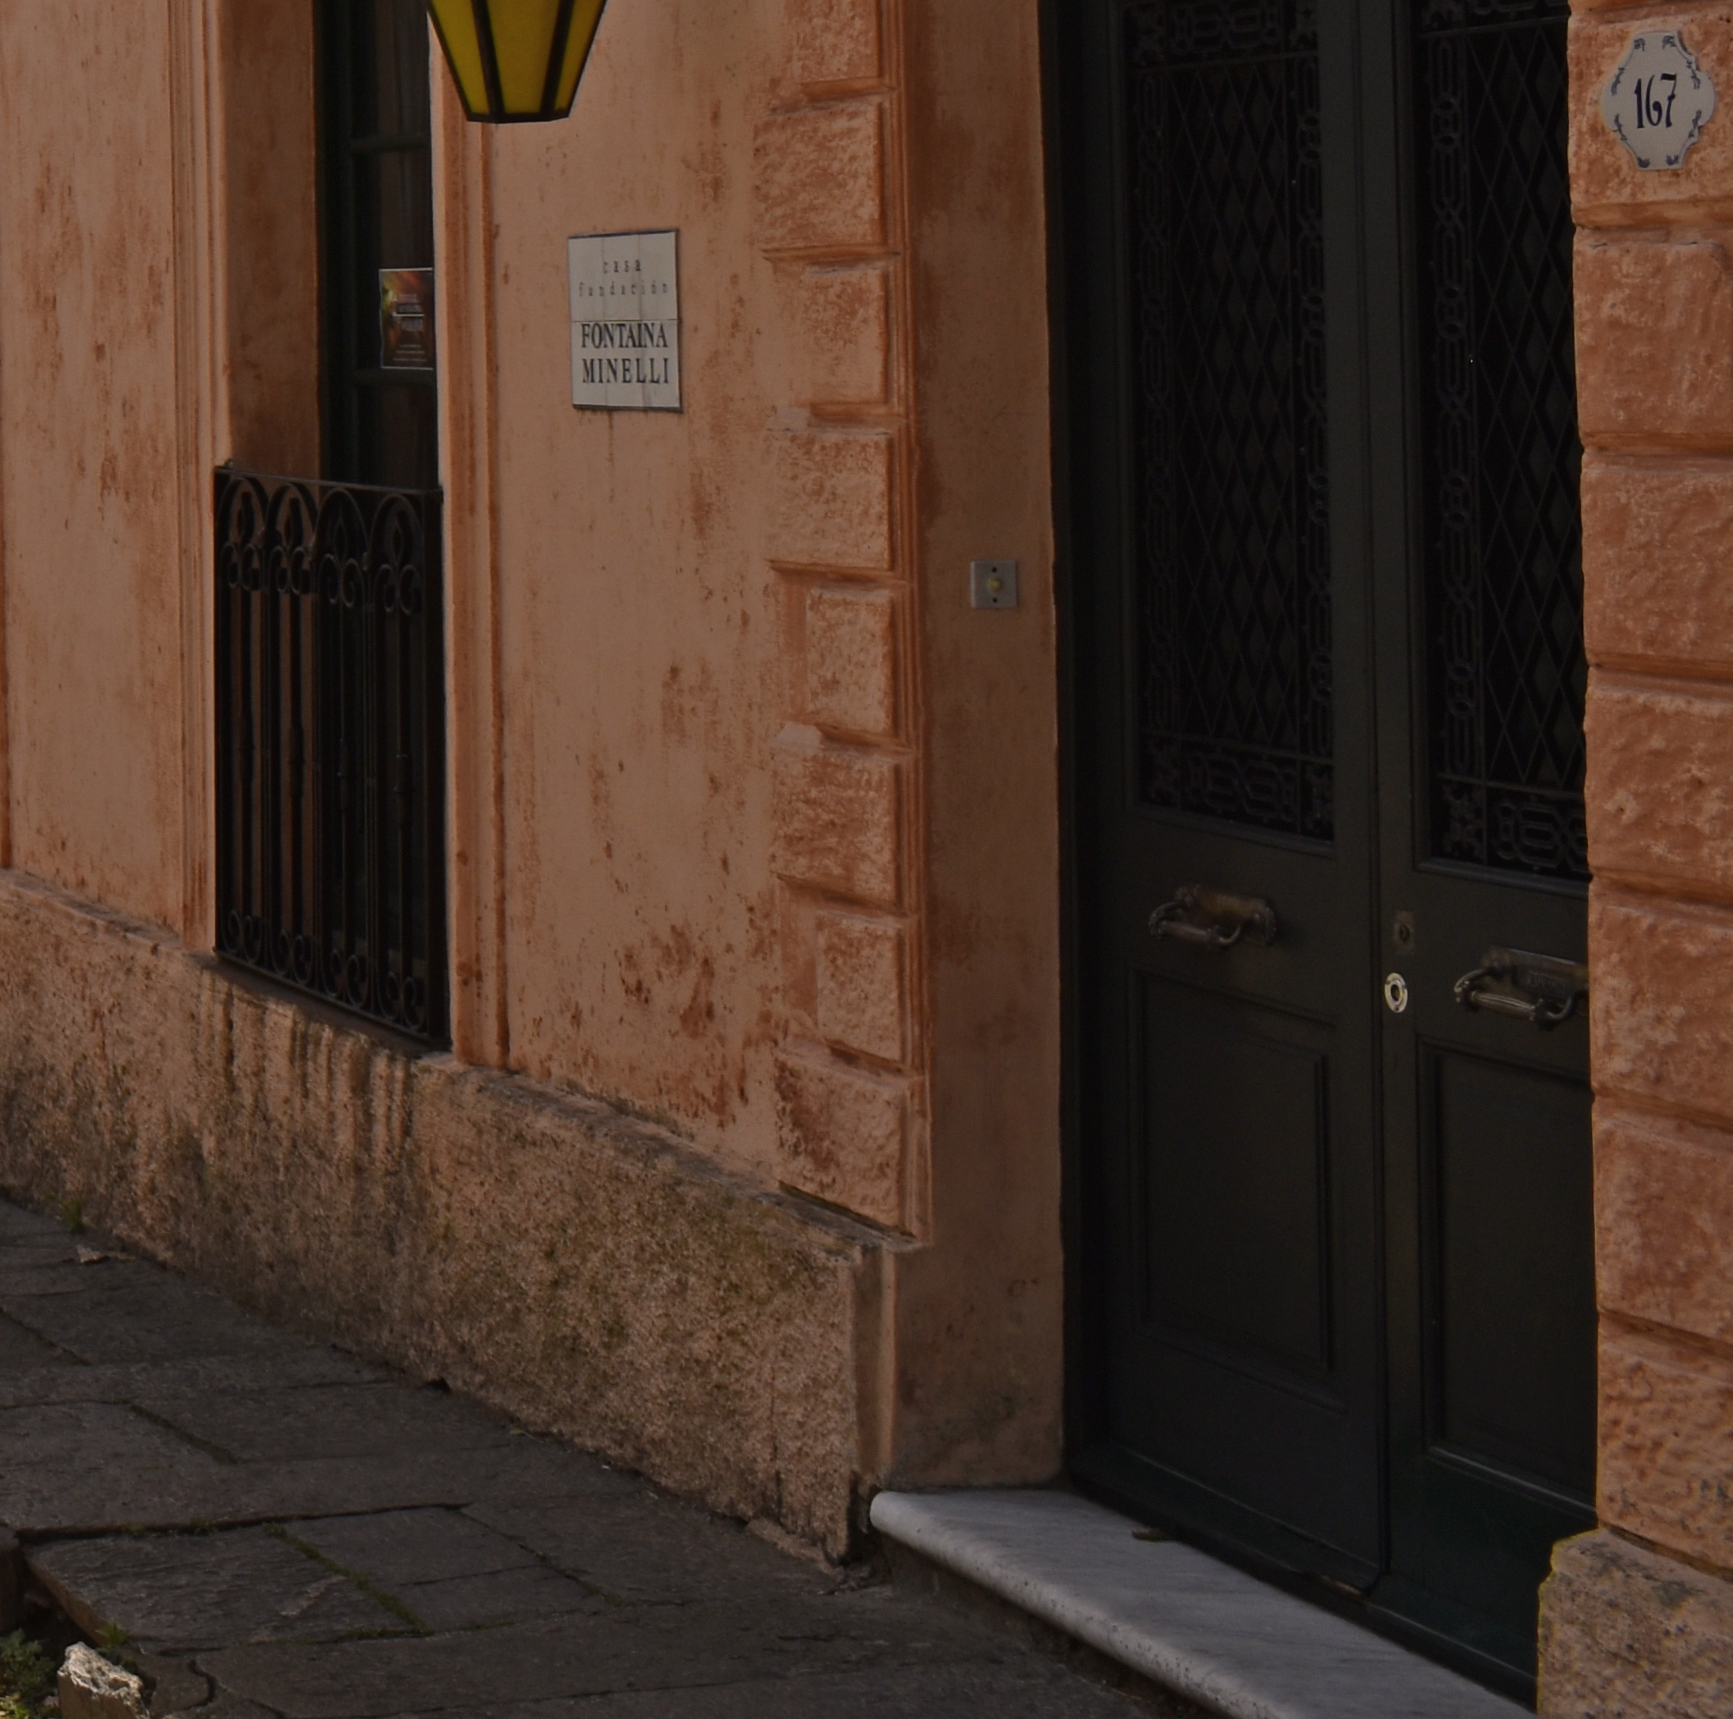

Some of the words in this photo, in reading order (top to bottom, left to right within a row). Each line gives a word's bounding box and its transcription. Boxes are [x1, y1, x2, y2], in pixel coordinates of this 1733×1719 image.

[1633, 73, 1677, 129] 167
[602, 259, 641, 274] casa
[578, 280, 668, 297] fundación
[581, 322, 669, 349] FONTAINA
[582, 357, 669, 384] MINELLI
